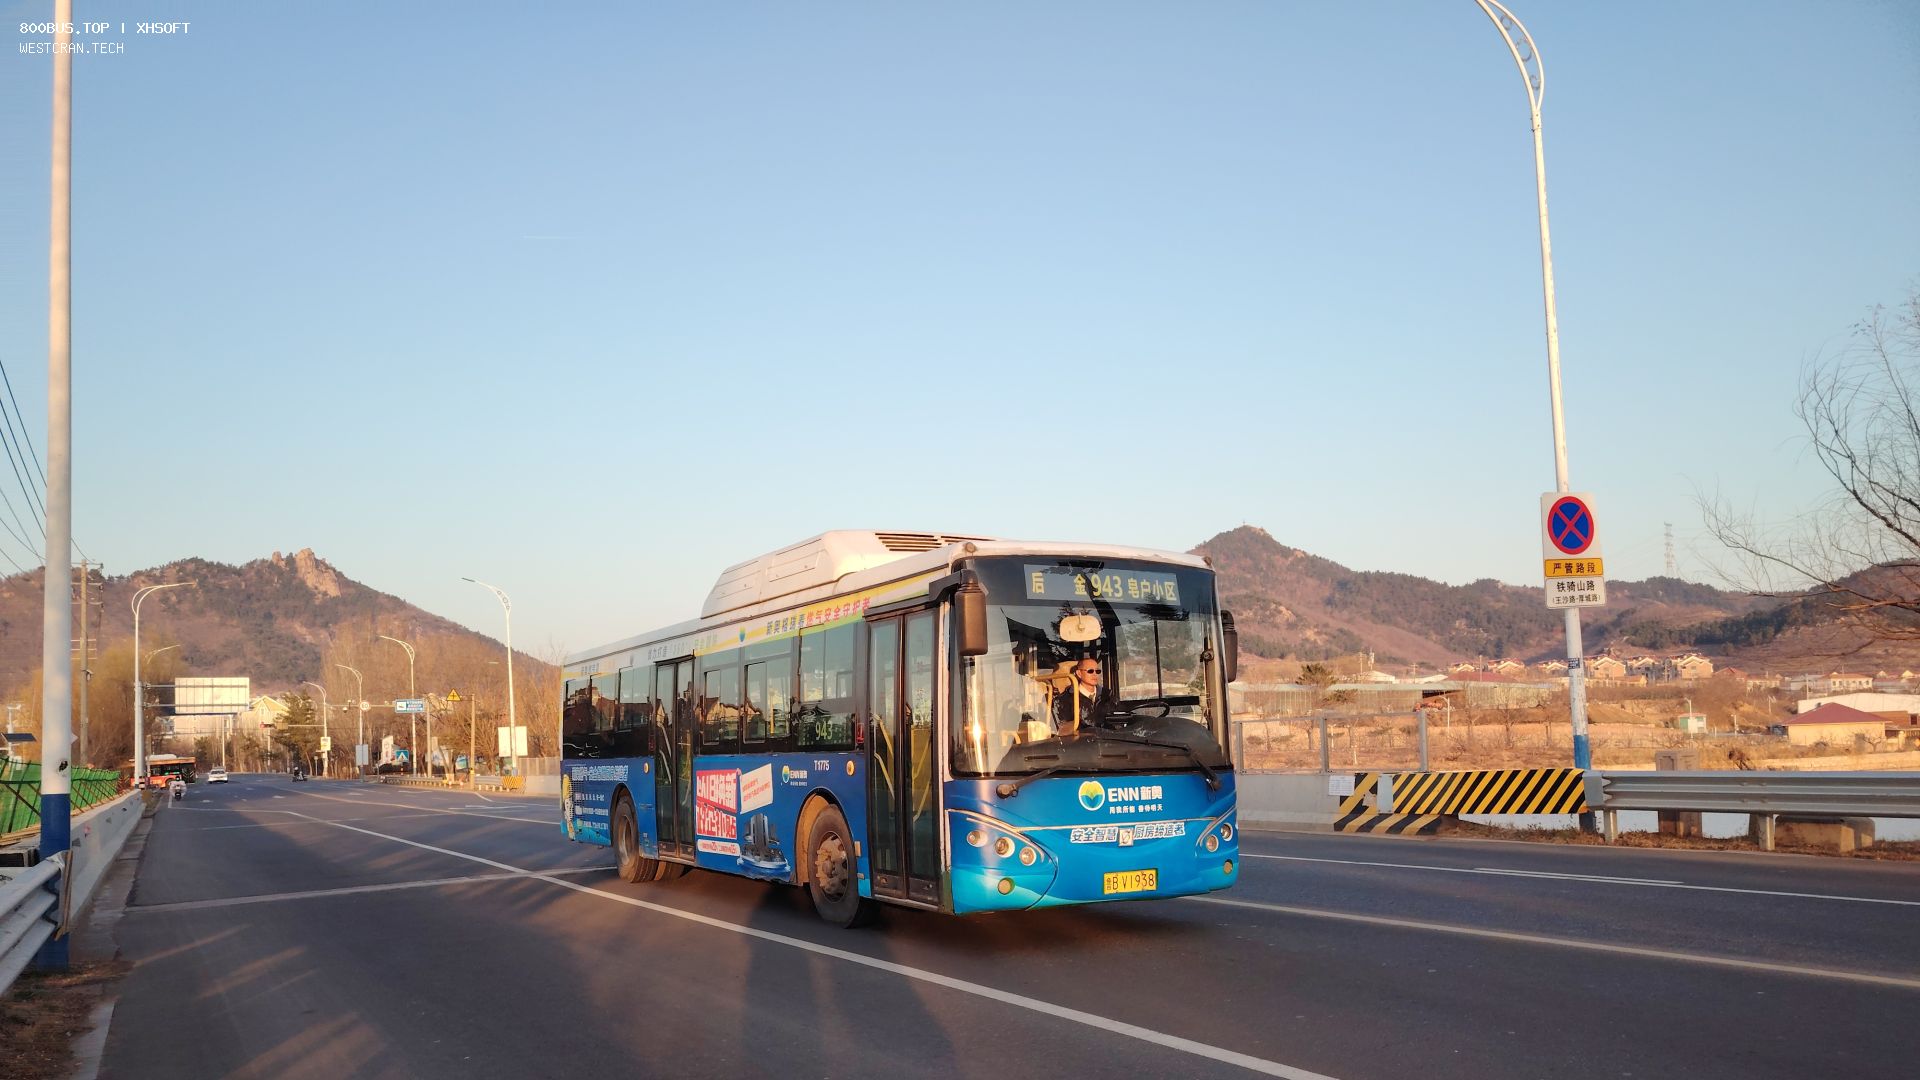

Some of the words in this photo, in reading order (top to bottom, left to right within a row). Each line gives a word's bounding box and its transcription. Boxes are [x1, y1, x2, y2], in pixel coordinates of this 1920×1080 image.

[1552, 562, 1596, 574] 严管路段
[1092, 573, 1123, 598] 943
[1556, 580, 1595, 592] 铁骑山路
[815, 720, 833, 741] 943
[814, 759, 830, 771] T1775
